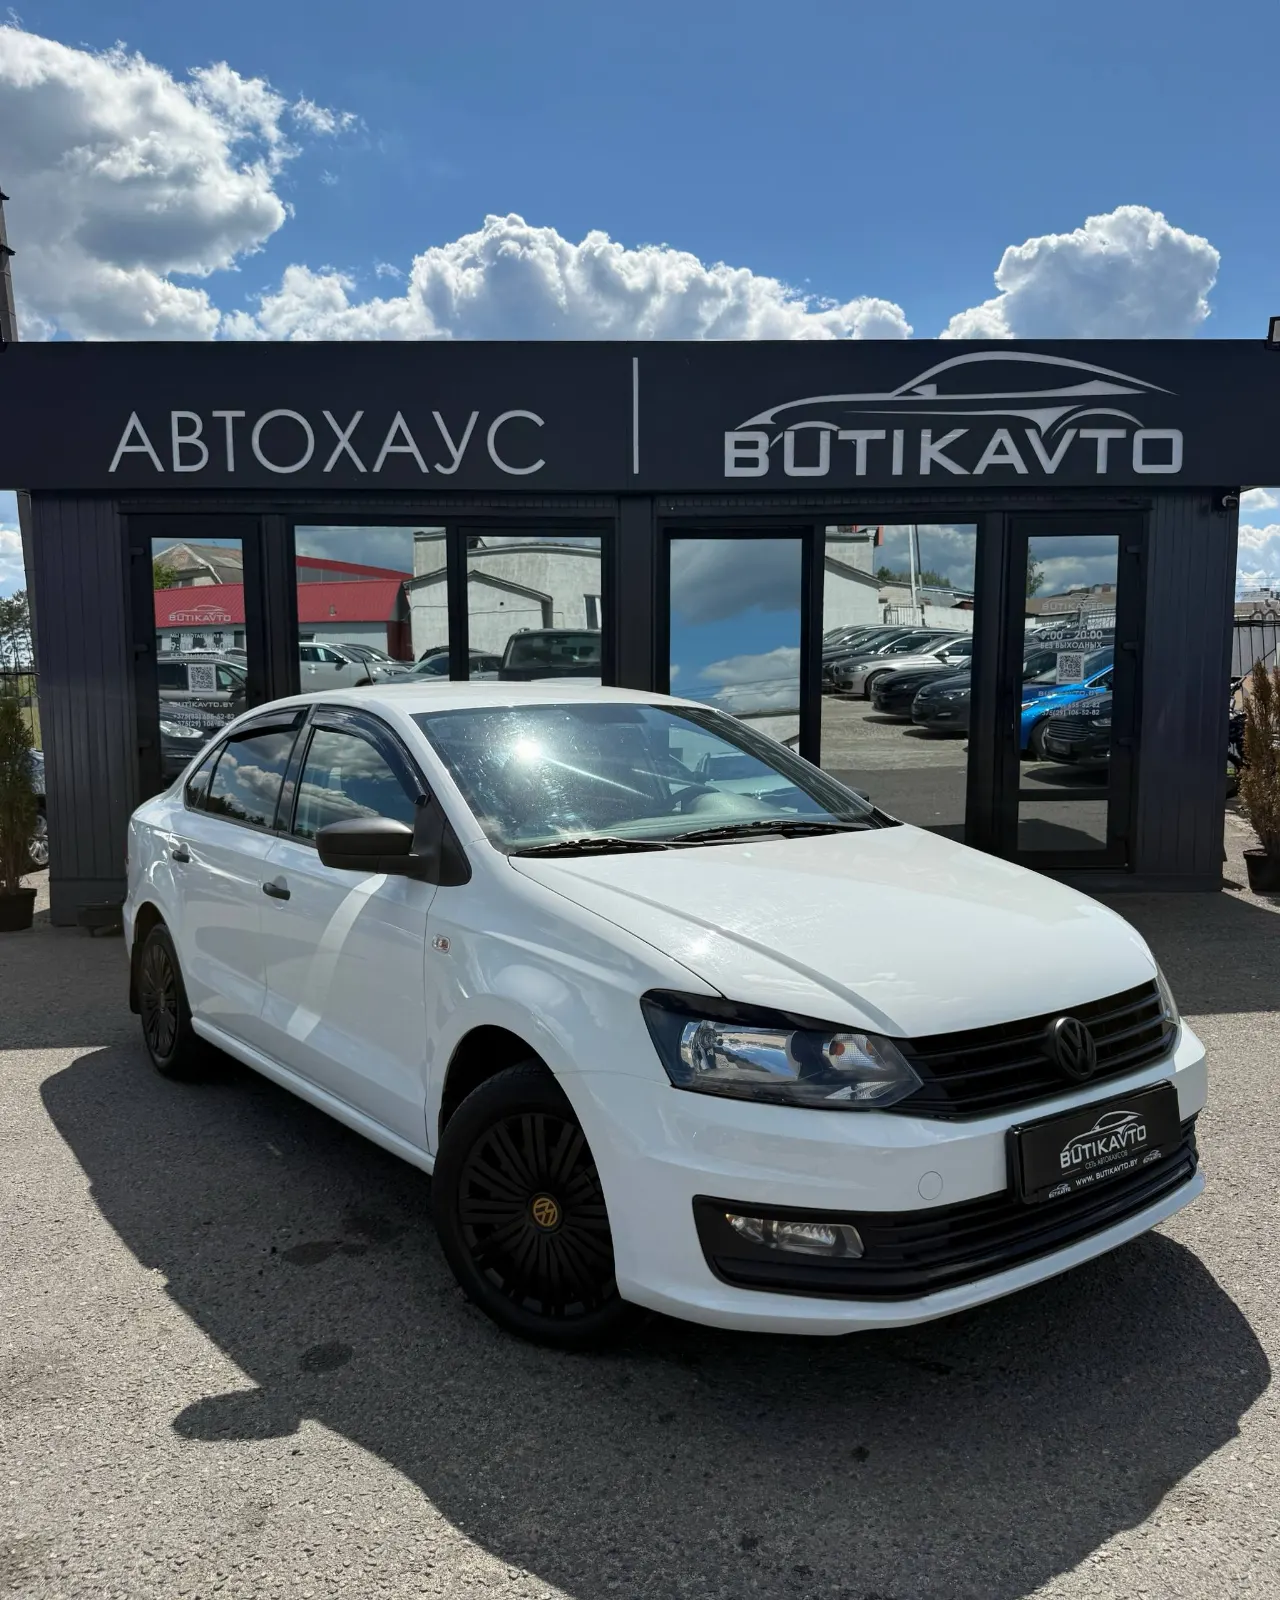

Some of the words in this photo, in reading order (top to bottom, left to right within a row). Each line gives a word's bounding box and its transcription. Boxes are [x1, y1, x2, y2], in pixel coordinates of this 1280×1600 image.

[108, 409, 545, 475] АВТОХАУС
[723, 428, 1184, 478] BUTIKAVTO
[169, 613, 232, 622] BUTIKAVTO
[1041, 630, 1063, 640] 9:00
[1075, 630, 1103, 640] 20:00
[1055, 641, 1103, 650] ВЫХОДНЫХ
[1060, 1125, 1147, 1169] BUTIKAVTO
[1096, 1158, 1138, 1180] BUTIKAVTO.BY
